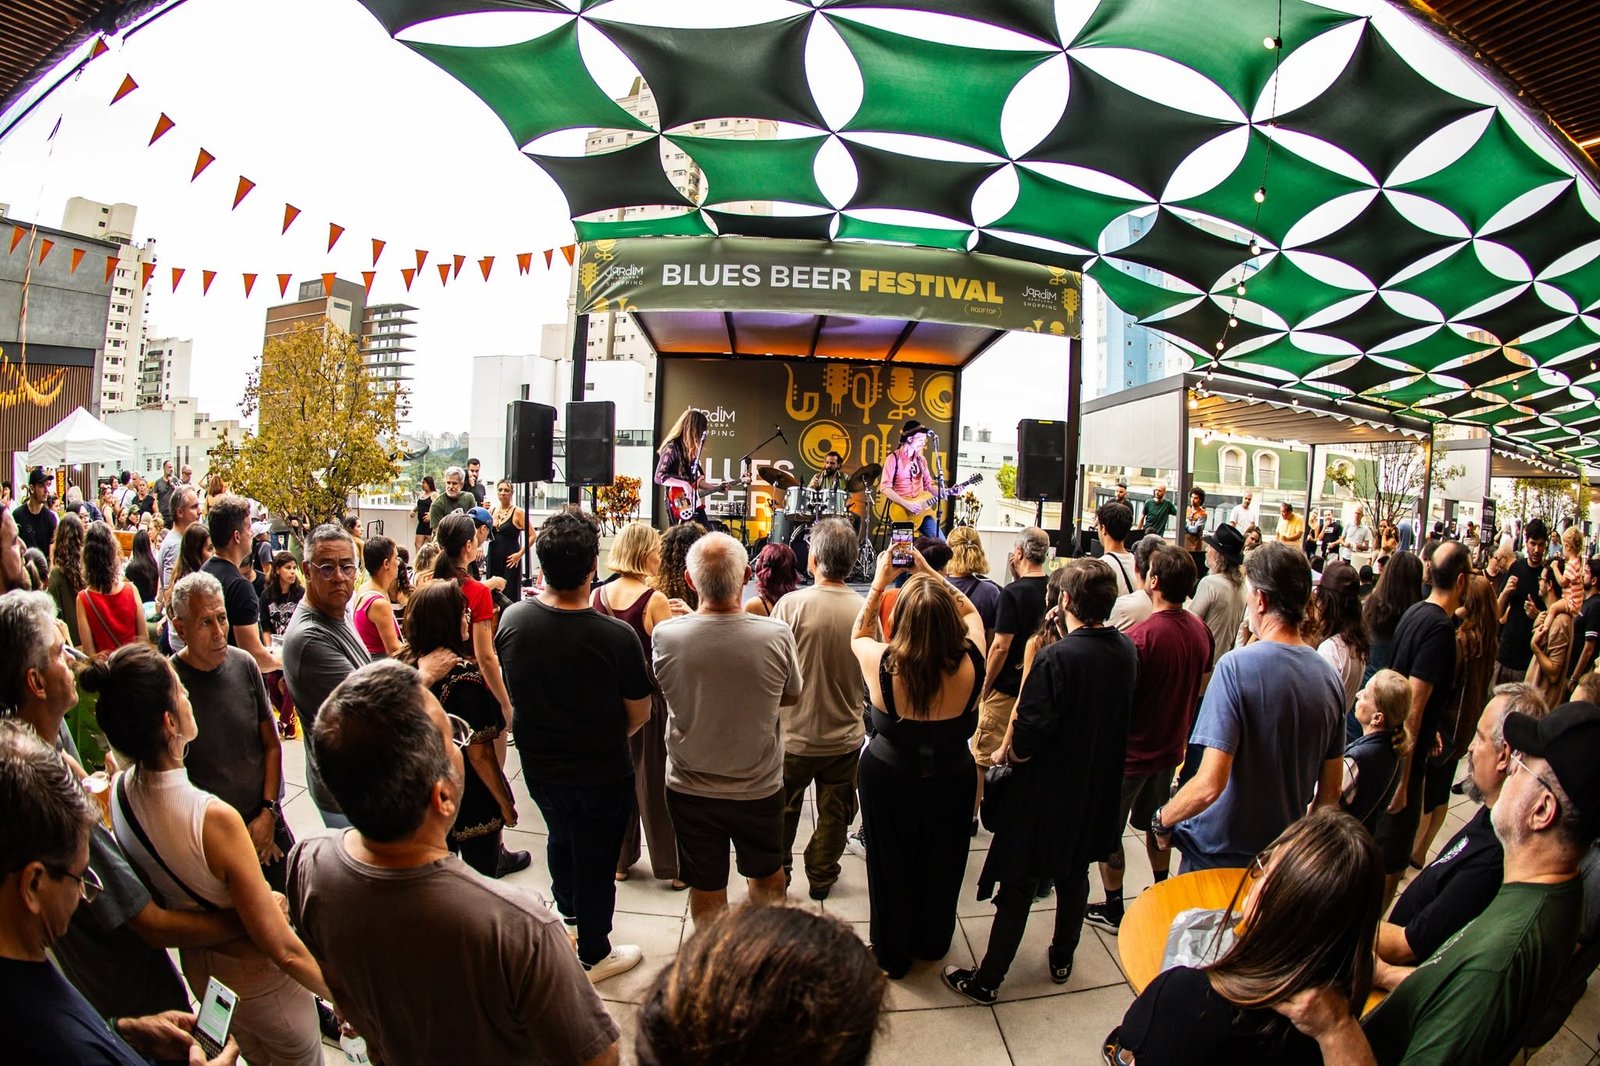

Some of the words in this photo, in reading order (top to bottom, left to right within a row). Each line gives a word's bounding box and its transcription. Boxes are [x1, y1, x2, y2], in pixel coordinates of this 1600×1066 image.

[662, 264, 761, 287] BLUES
[770, 265, 852, 290] BEER
[859, 269, 1004, 304] FESTIVAL
[1023, 301, 1057, 311] SHOPPING
[705, 457, 795, 486] LUES
[705, 490, 772, 517] EER
